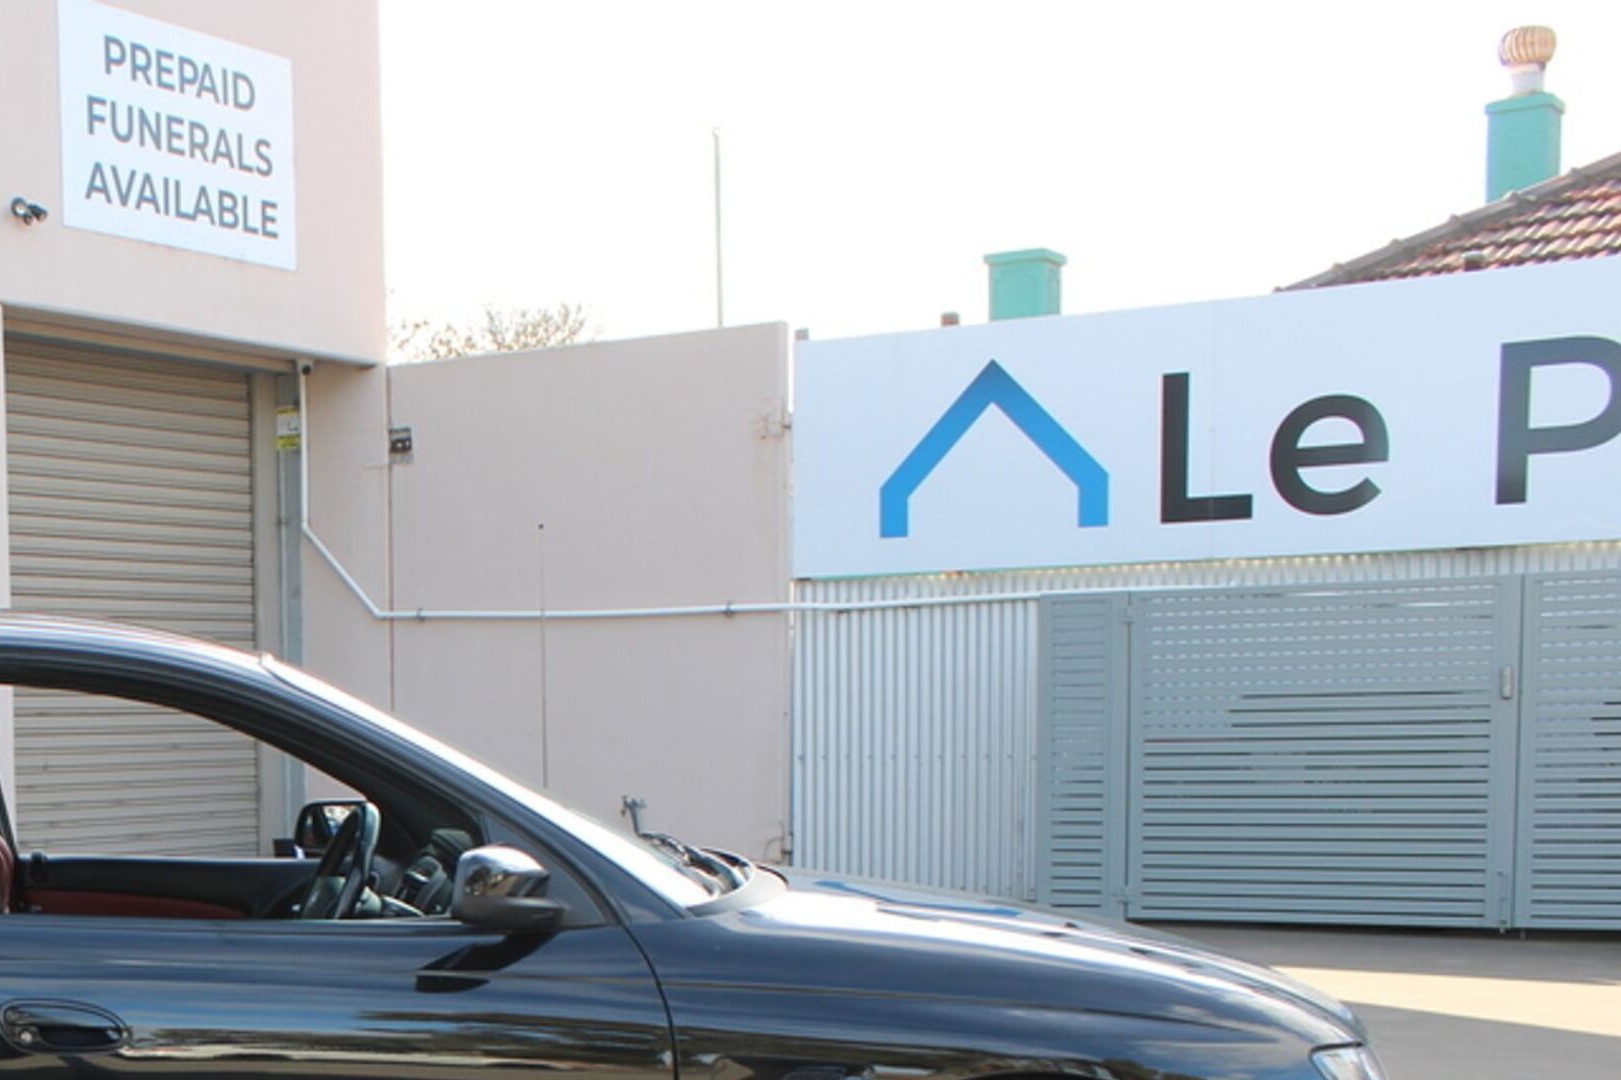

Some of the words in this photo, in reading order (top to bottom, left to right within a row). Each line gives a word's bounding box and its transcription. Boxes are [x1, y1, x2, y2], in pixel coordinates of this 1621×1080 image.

[103, 34, 256, 111] PREPAID
[86, 95, 274, 178] FUNERALS
[84, 161, 279, 239] AVAILABLE
[1159, 371, 1390, 525] Le
